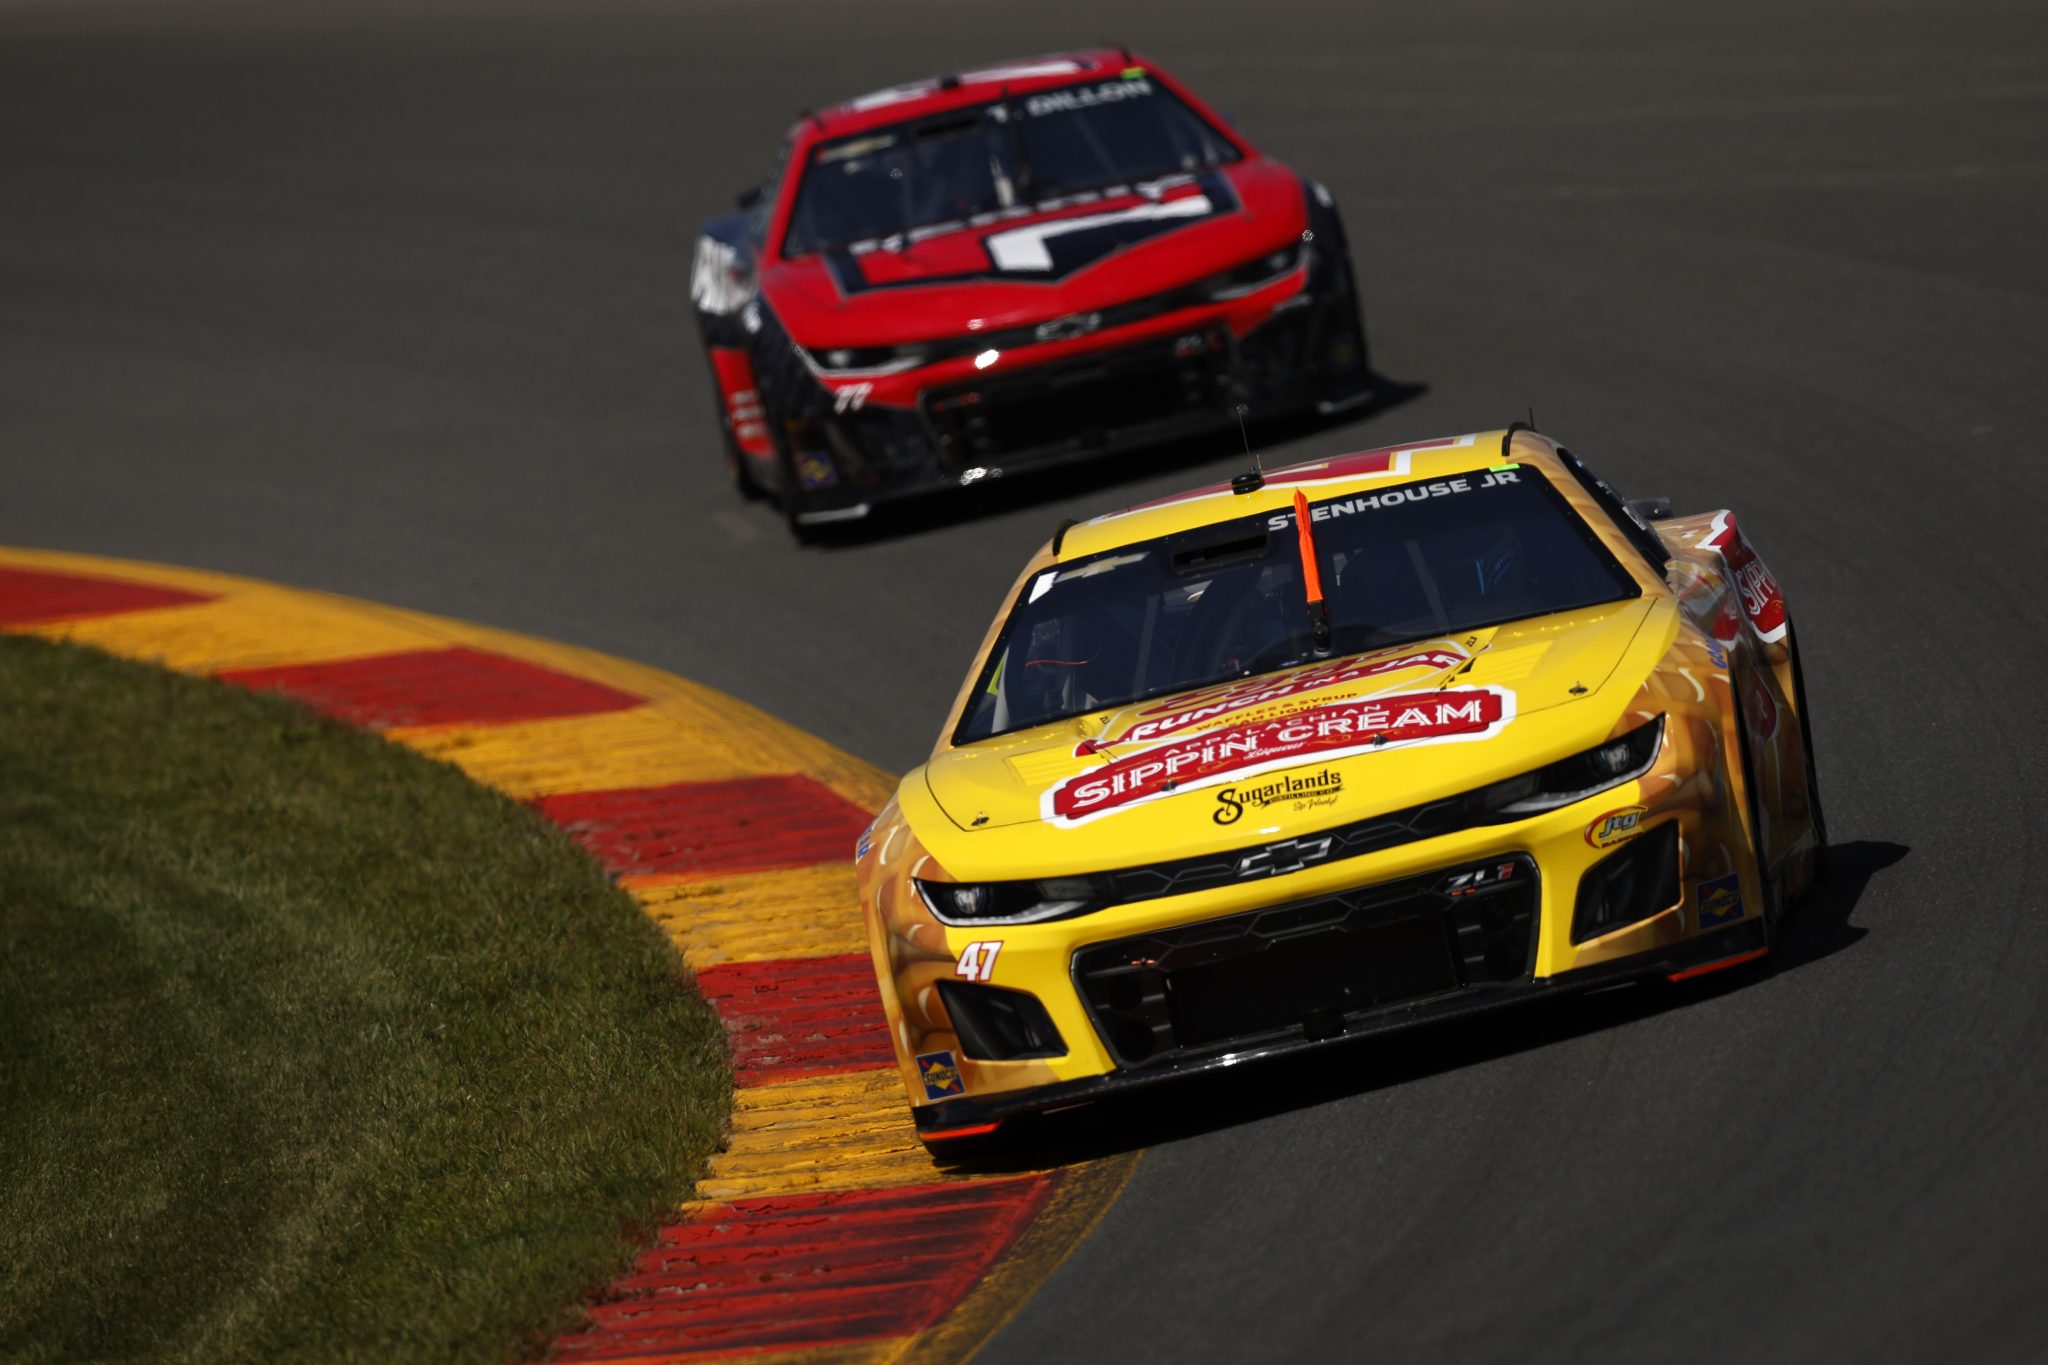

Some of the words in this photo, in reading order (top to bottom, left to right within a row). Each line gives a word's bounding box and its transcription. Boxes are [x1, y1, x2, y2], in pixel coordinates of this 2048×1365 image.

[834, 381, 874, 414] 77
[1481, 471, 1521, 488] JR
[1124, 685, 1294, 741] RUNCH
[1164, 704, 1381, 757] APPALACHIAN
[1196, 706, 1277, 731] WAFFLES
[1299, 692, 1358, 704] SYRUP
[1277, 699, 1482, 742] CREAM
[1213, 769, 1342, 825] Sugarlands
[1445, 862, 1514, 894] ZL1
[956, 940, 1003, 982] 47
